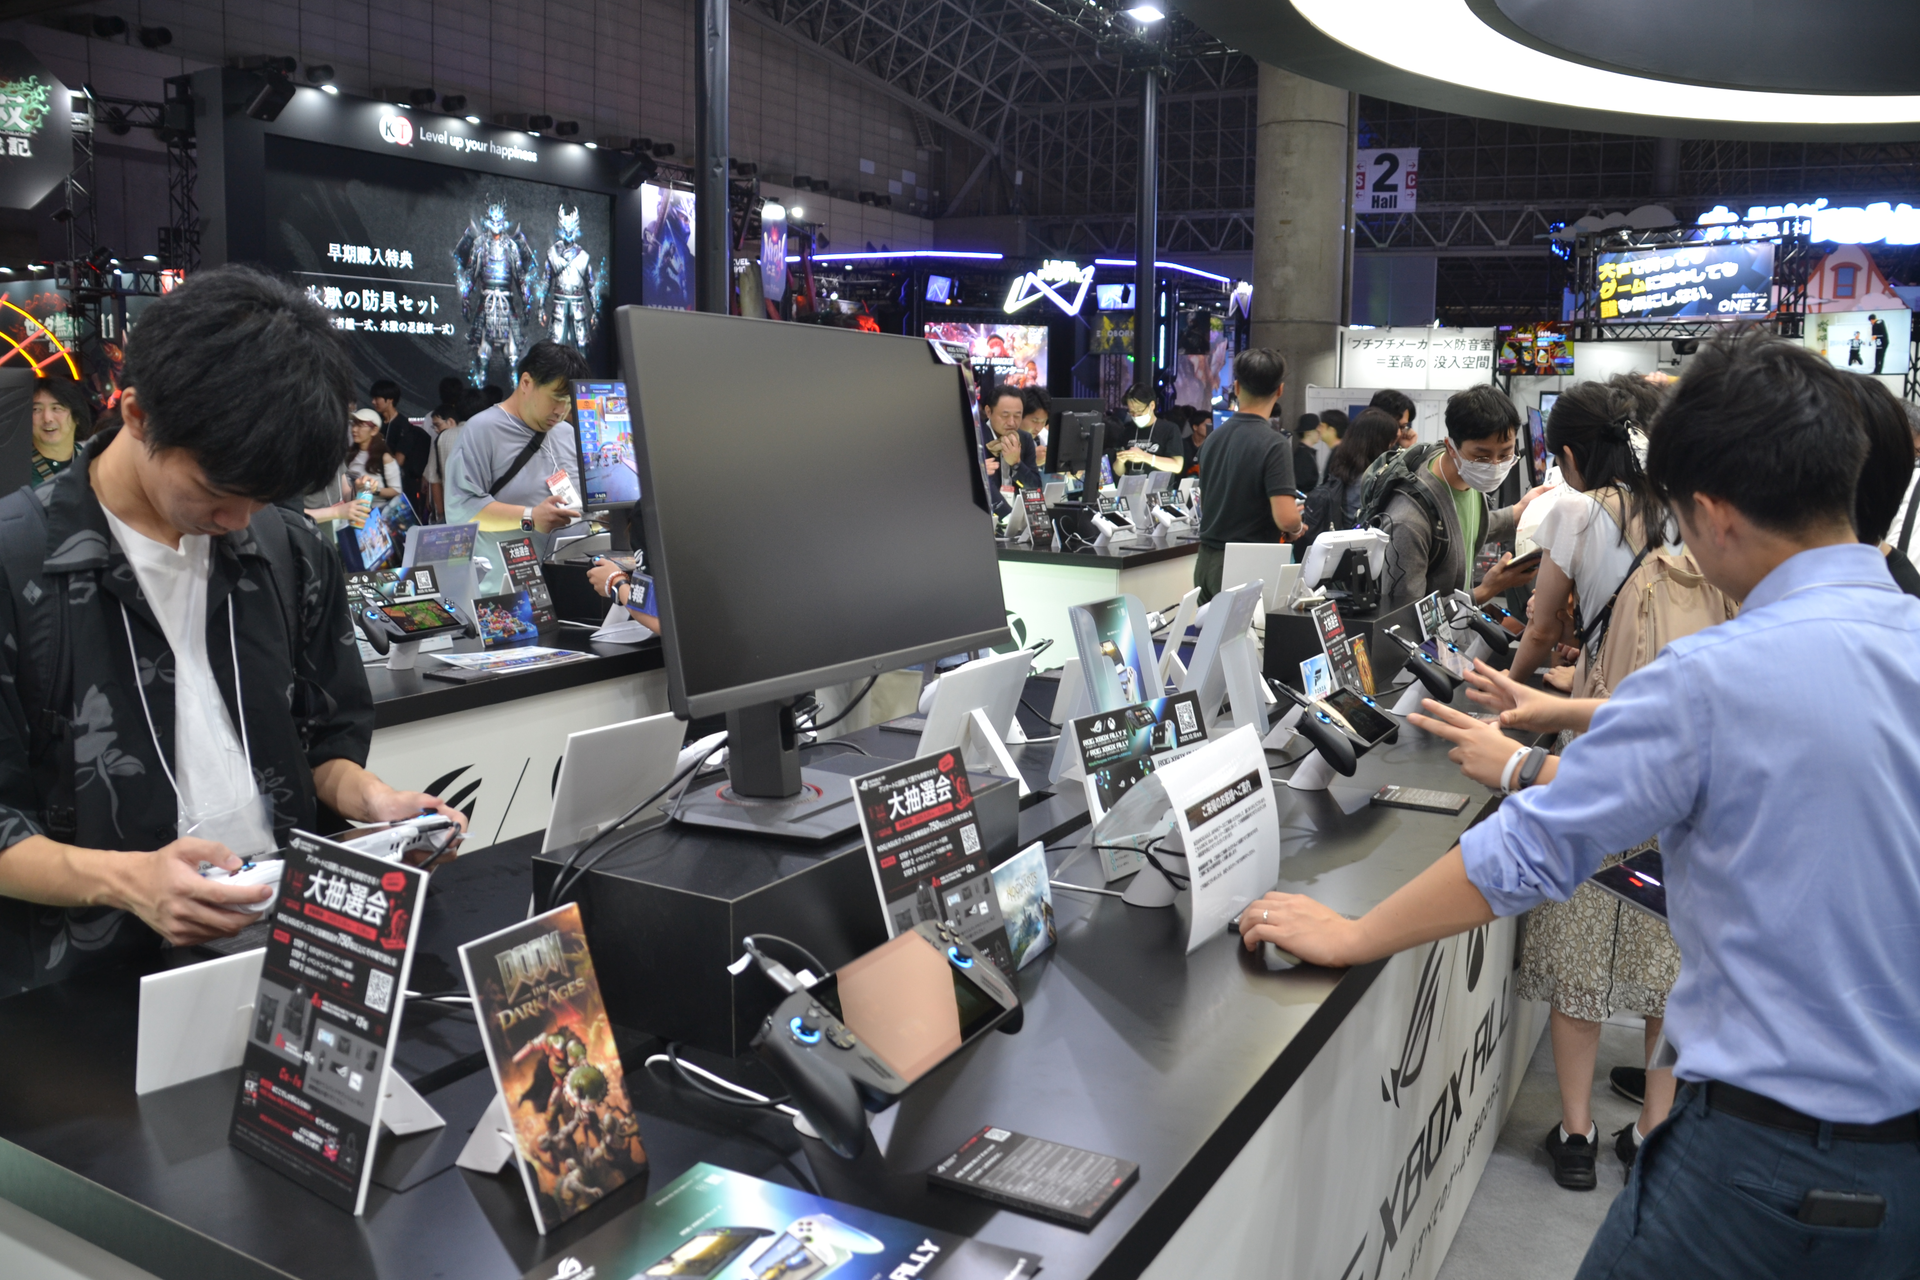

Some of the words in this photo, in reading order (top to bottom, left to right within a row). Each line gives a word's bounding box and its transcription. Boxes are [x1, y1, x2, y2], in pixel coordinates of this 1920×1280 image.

[0, 136, 33, 157] 記
[420, 127, 448, 144] Level
[450, 137, 464, 151] up
[465, 138, 488, 153] your
[490, 140, 538, 163] happiness
[1356, 175, 1364, 187] S
[1372, 152, 1400, 192] 2
[1407, 174, 1416, 186] C
[1371, 195, 1398, 209] Hall
[327, 242, 414, 269] 早期購入特典
[887, 774, 952, 820] 大抽選会
[304, 869, 388, 926] 大抽選会
[494, 930, 571, 1005] DOOM
[496, 996, 546, 1031] DARK
[547, 977, 586, 1009] AGES
[532, 984, 548, 996] THE
[1373, 1047, 1468, 1280] XBOX
